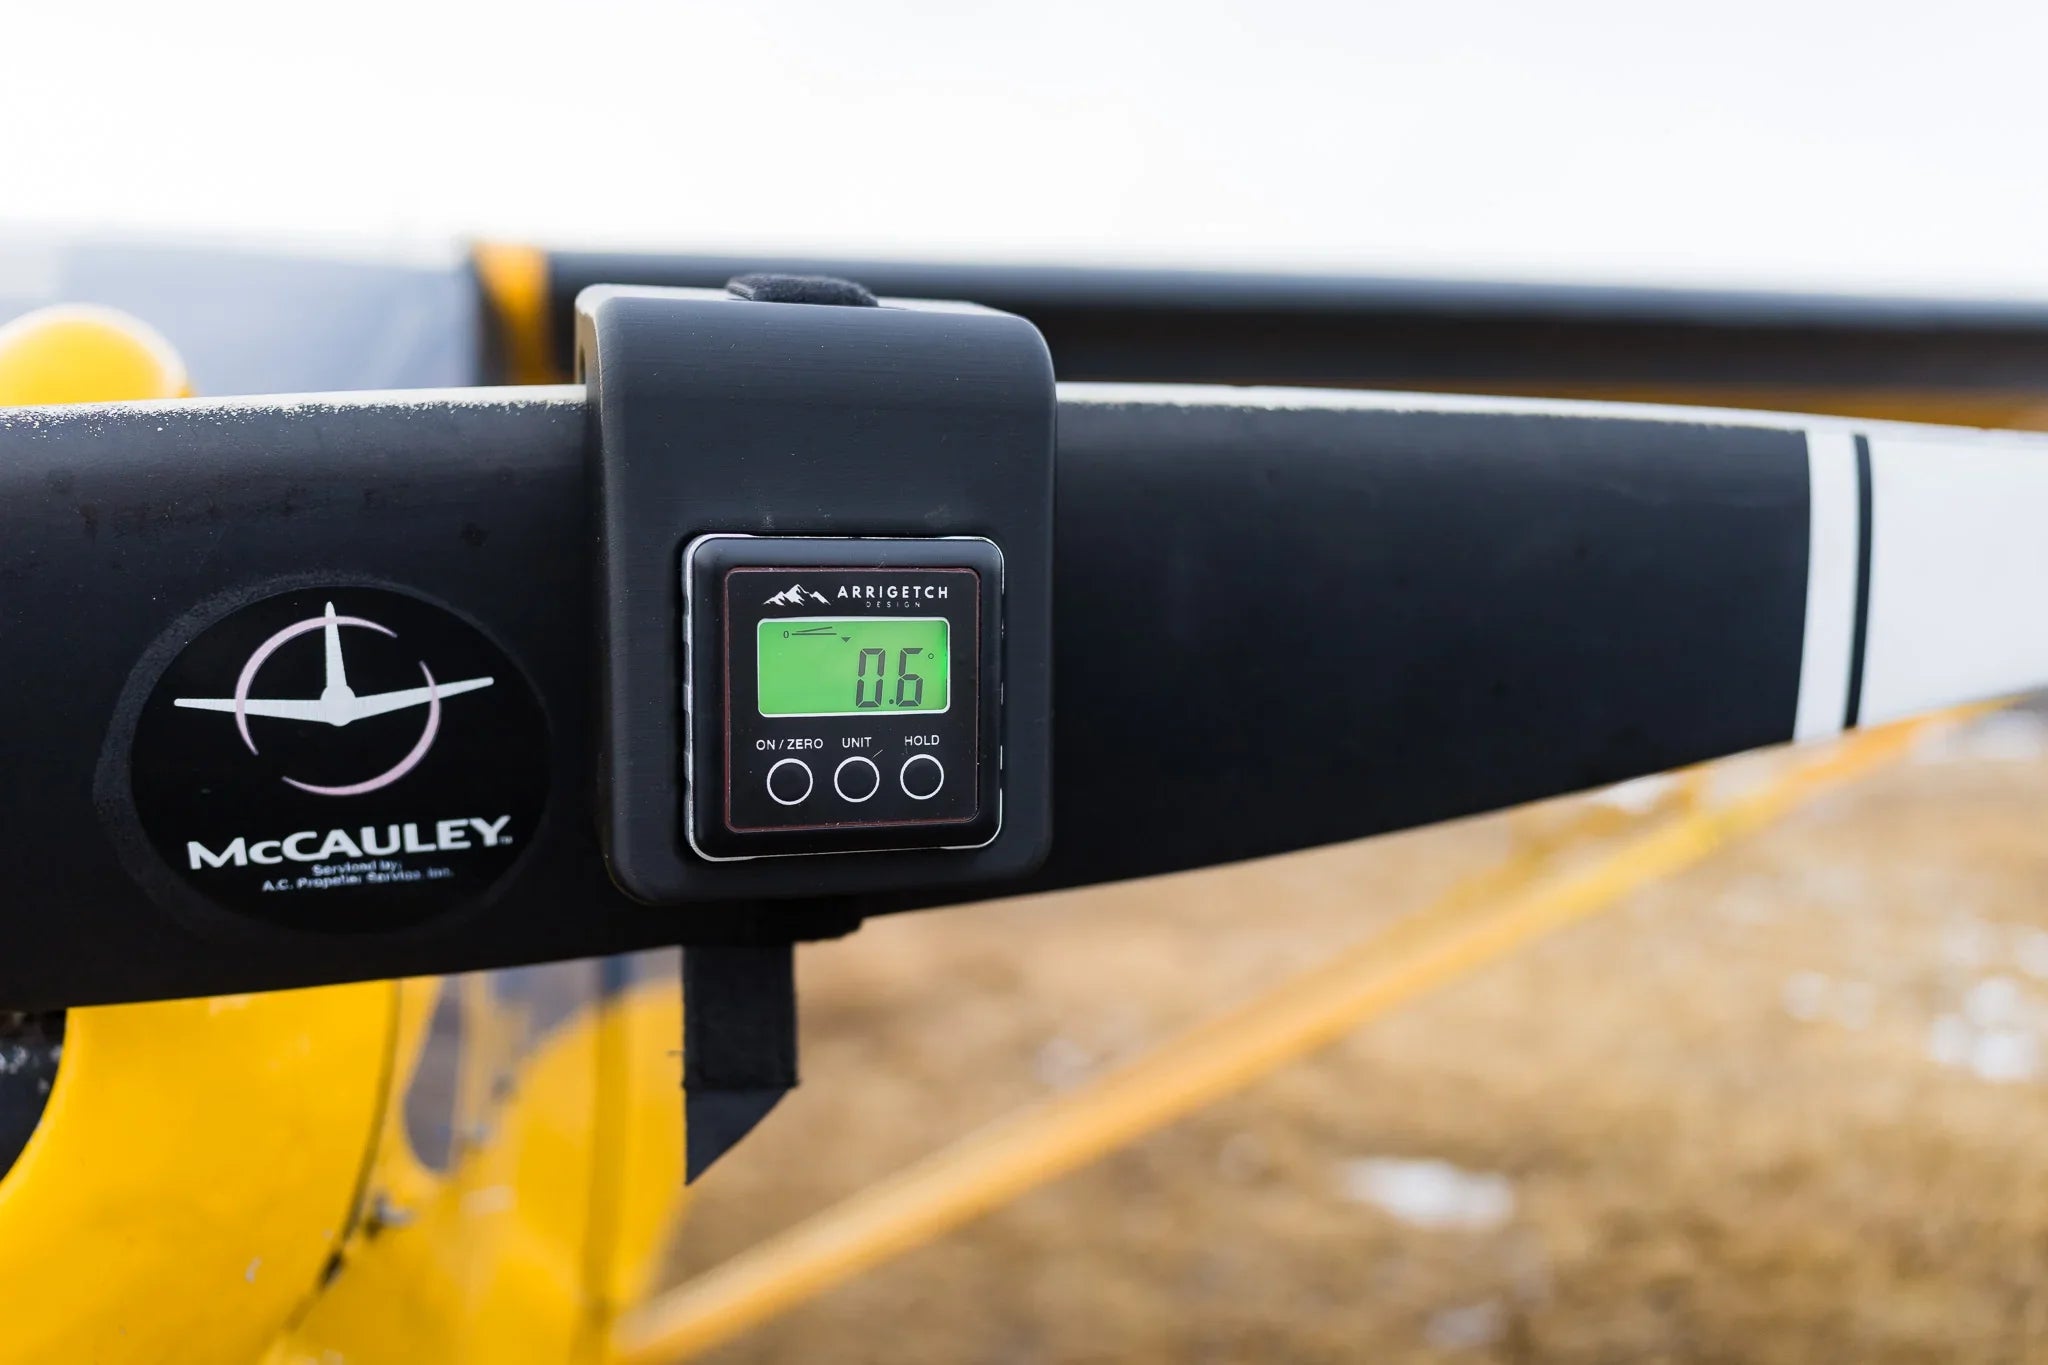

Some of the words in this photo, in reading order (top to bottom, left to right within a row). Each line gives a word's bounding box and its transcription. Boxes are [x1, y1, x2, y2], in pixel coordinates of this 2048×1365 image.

[837, 585, 948, 598] ARRIGETCH
[842, 736, 872, 748] UNIT
[904, 734, 940, 746] HOLD
